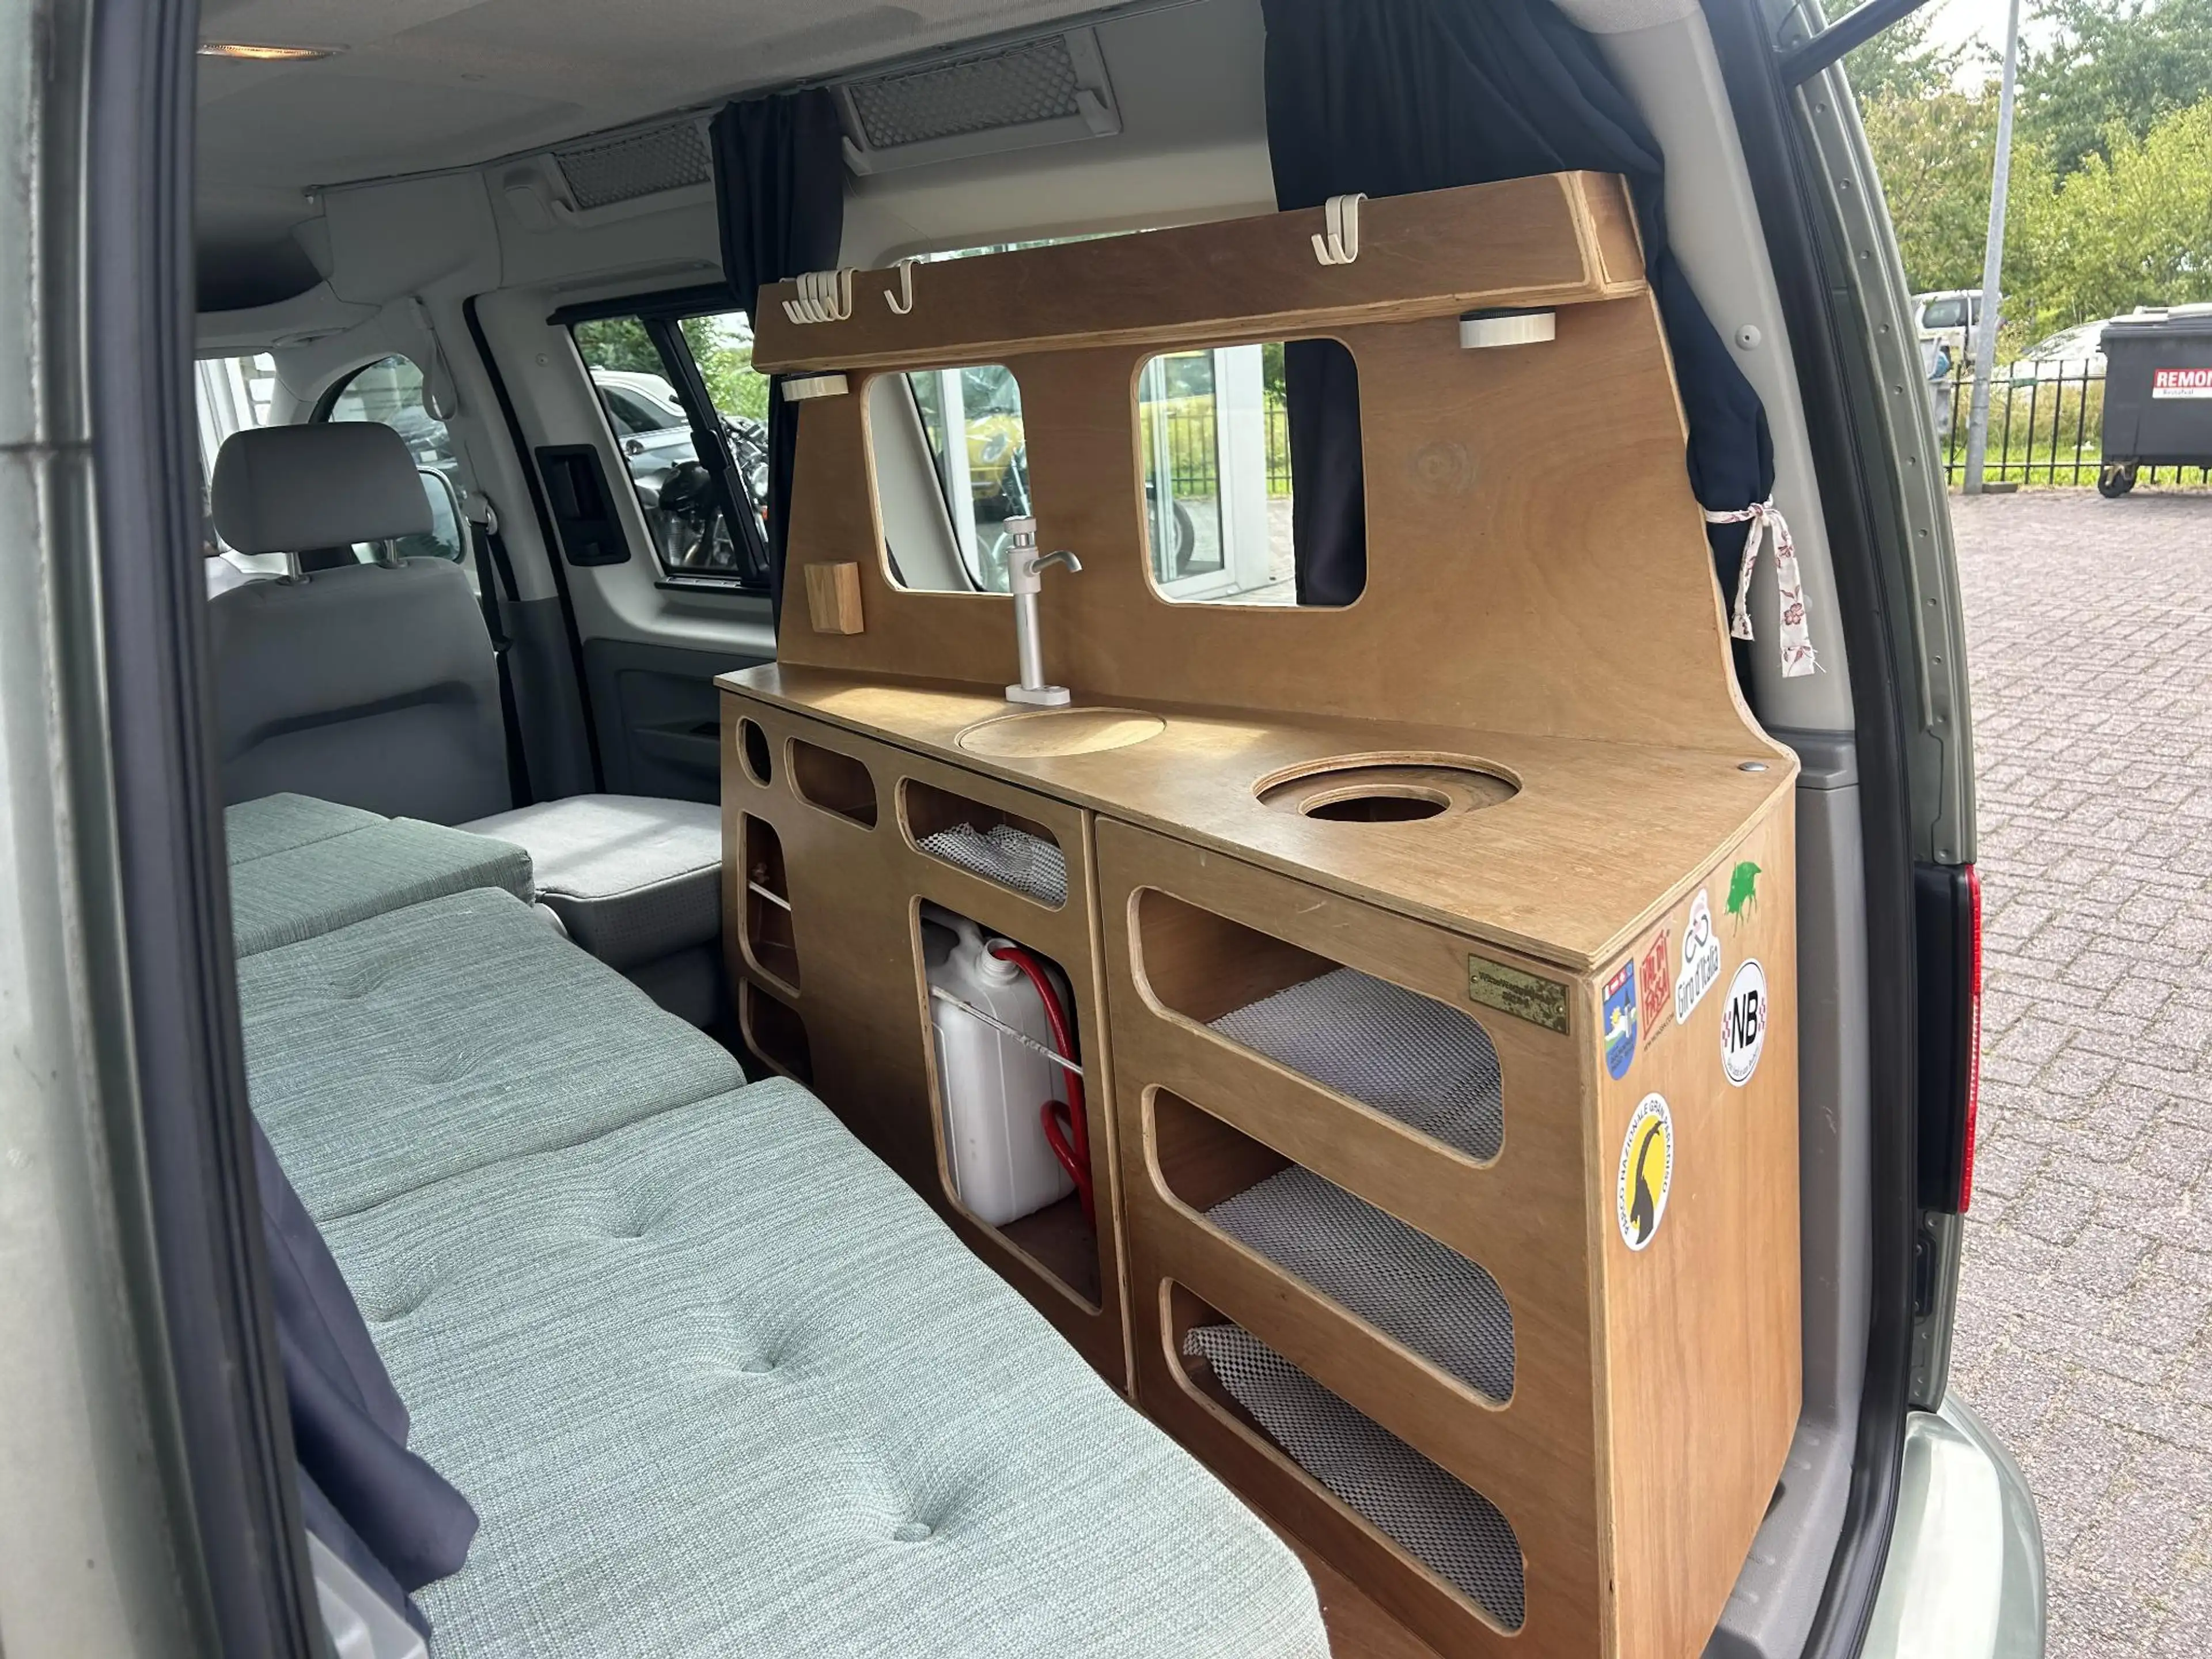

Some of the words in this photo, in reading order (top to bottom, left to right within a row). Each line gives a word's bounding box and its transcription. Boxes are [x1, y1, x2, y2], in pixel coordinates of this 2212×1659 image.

[1678, 976, 1694, 1018] Giro
[1695, 945, 1718, 996] d'Italia
[1731, 990, 1758, 1054] NB
[1620, 1102, 1648, 1180] NAZIONALE
[1649, 1100, 1665, 1120] GRAN
